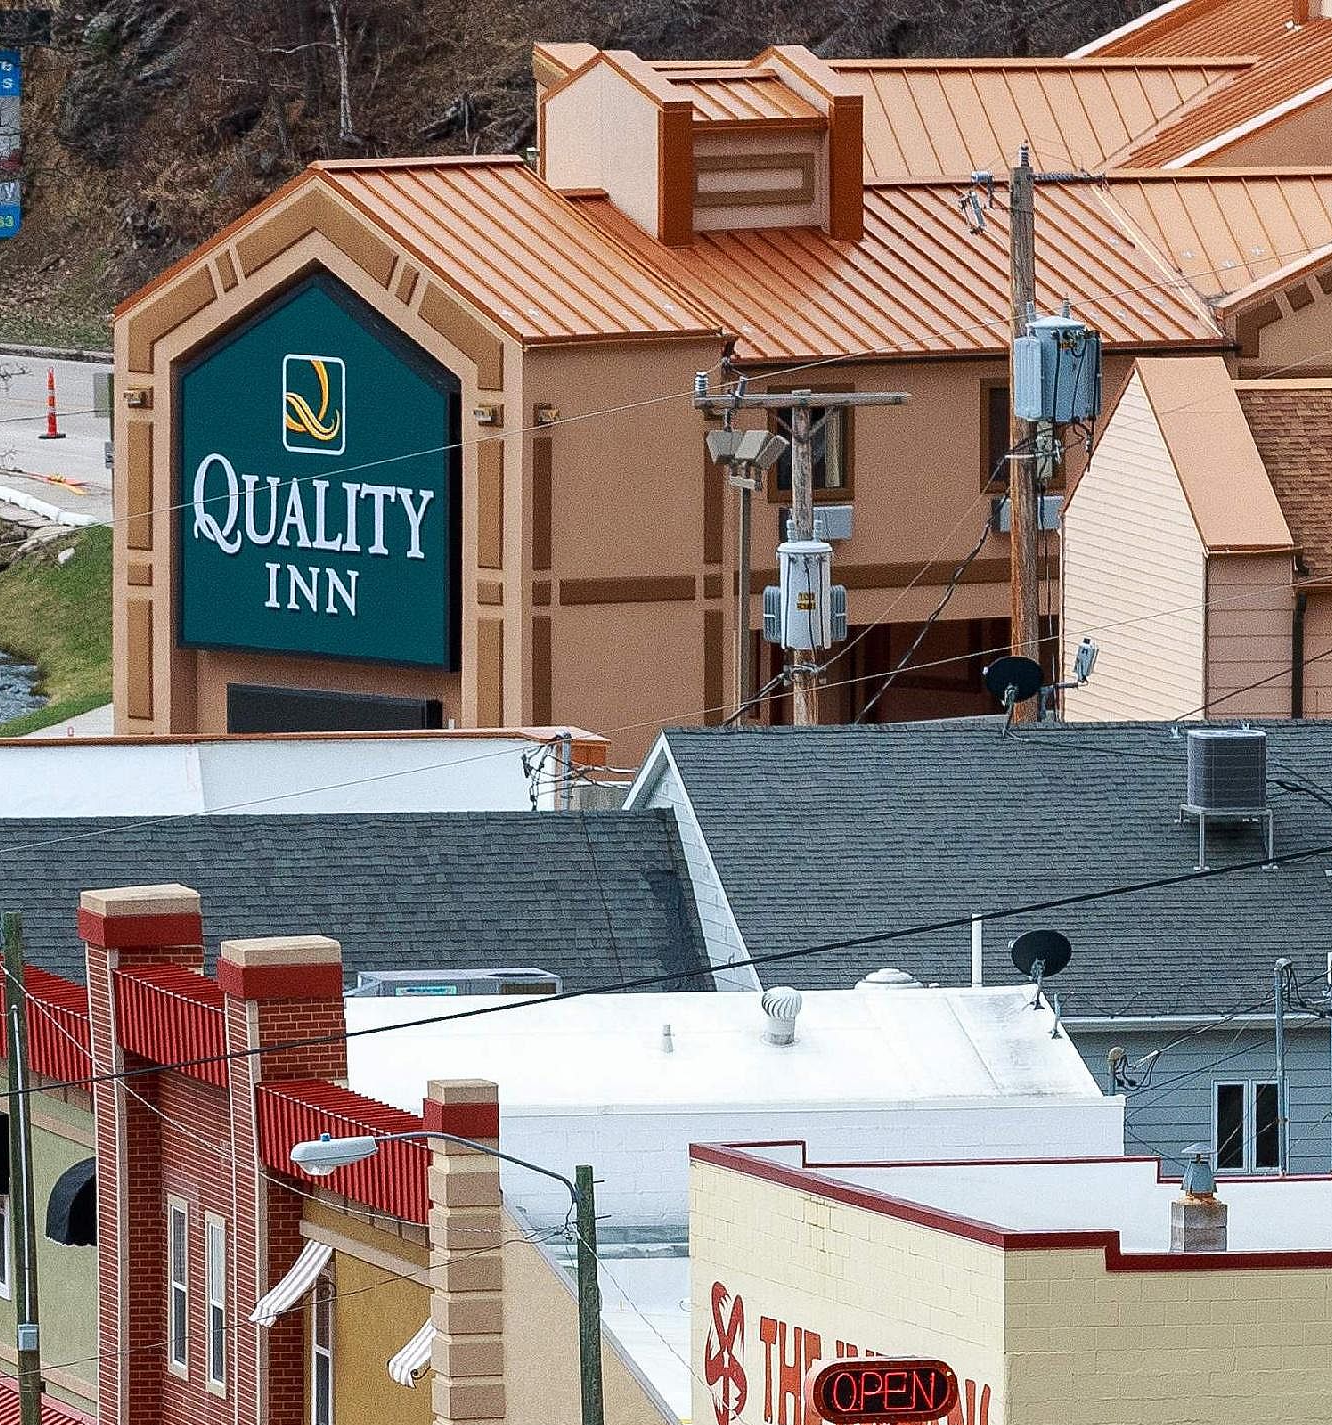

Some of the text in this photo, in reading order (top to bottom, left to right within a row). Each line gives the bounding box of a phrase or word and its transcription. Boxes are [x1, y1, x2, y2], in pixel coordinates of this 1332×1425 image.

[193, 453, 435, 559] QUALITY
[264, 562, 360, 617] INN
[833, 1370, 935, 1412] OPEN
